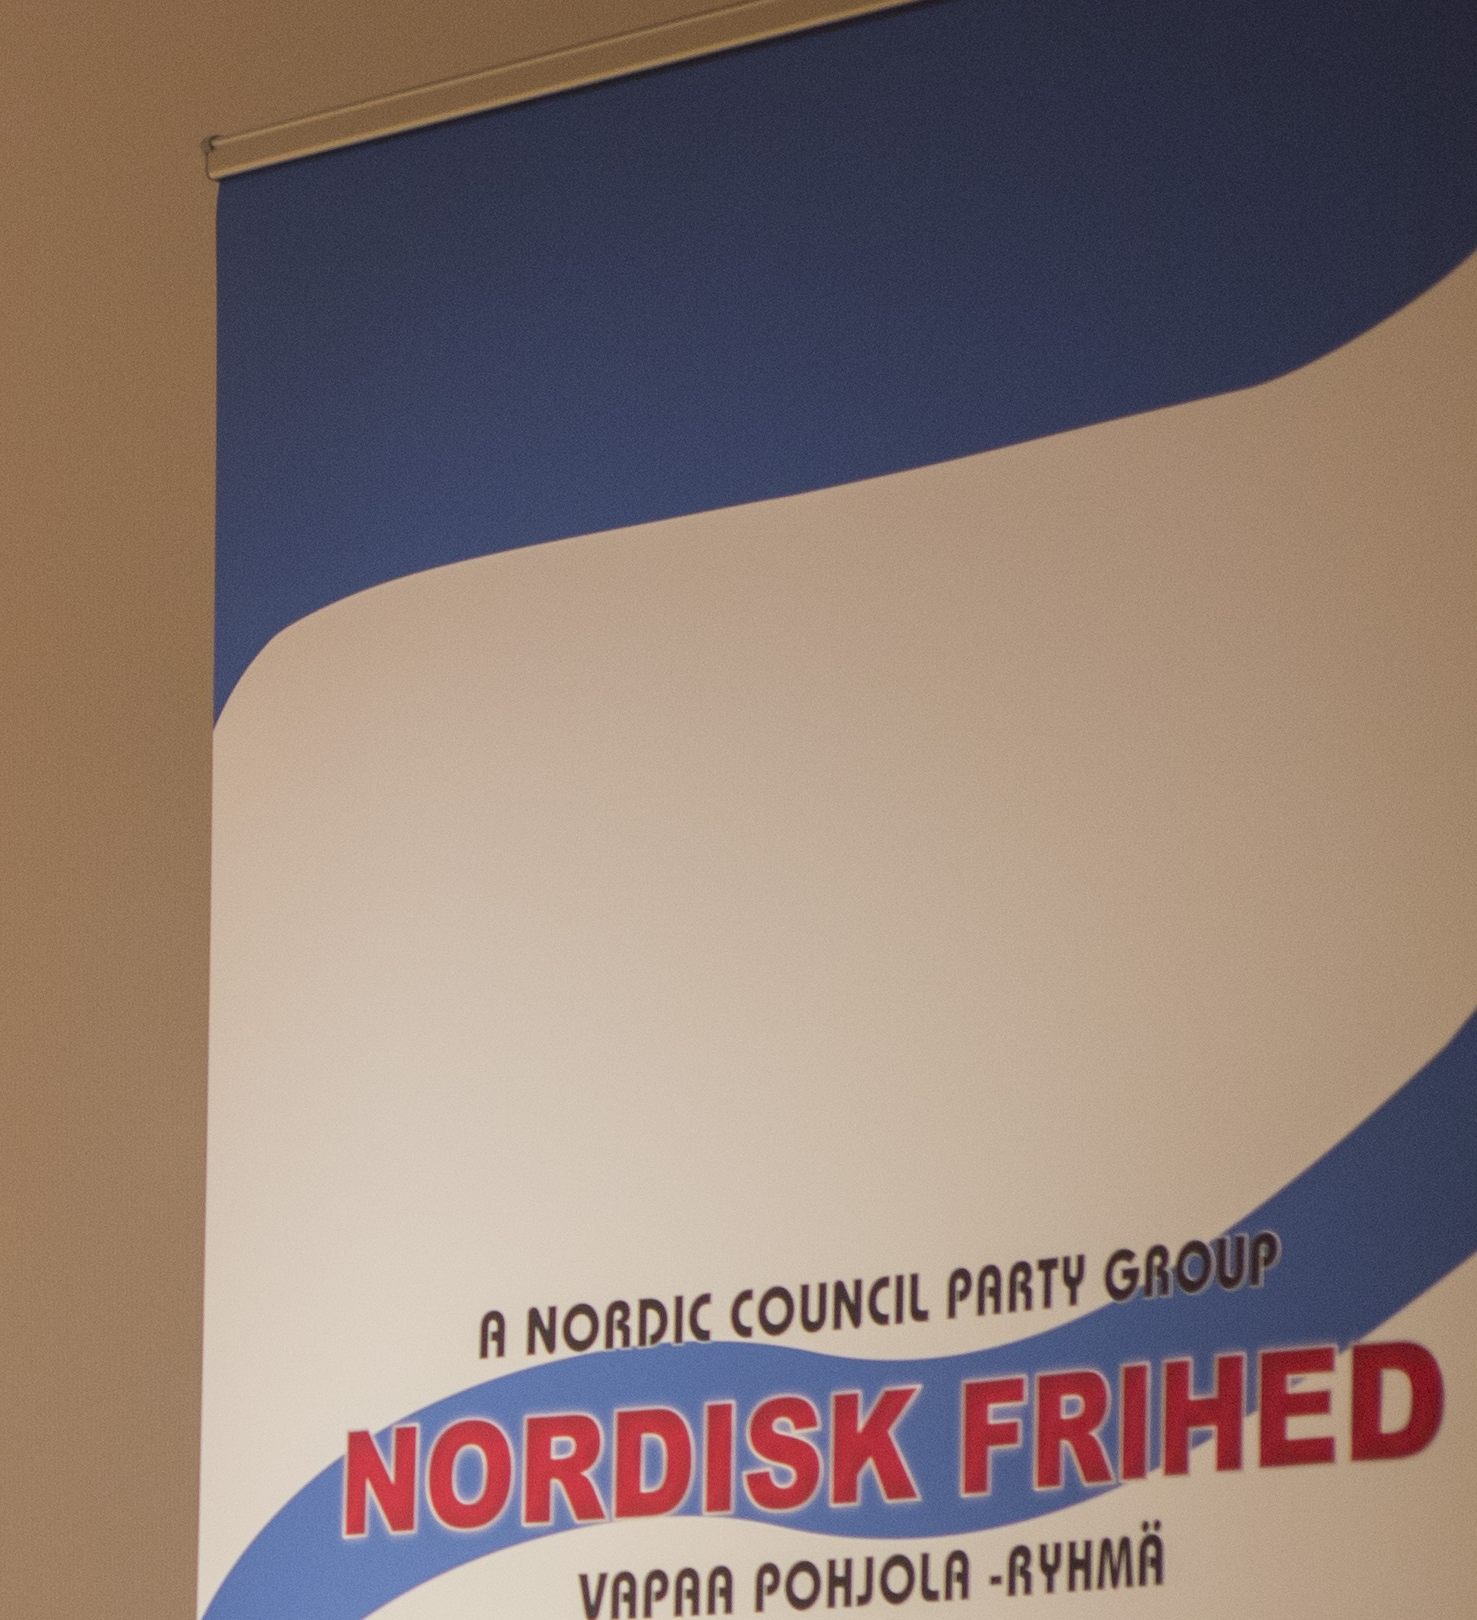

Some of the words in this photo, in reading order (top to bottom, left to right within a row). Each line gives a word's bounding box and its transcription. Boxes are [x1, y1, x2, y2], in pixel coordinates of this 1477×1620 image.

[479, 1311, 505, 1359] A
[525, 1292, 712, 1356] NORDIC
[730, 1273, 929, 1338] COUNCIL
[947, 1254, 1085, 1320] PARTY
[1103, 1232, 1281, 1302] GROUP
[343, 1384, 923, 1539] NORDISK
[959, 1340, 1446, 1496] FRIHED
[579, 1565, 733, 1620] VAPAA
[755, 1549, 969, 1612] POHJOLA
[989, 1520, 1165, 1597] -RYHMÄ
